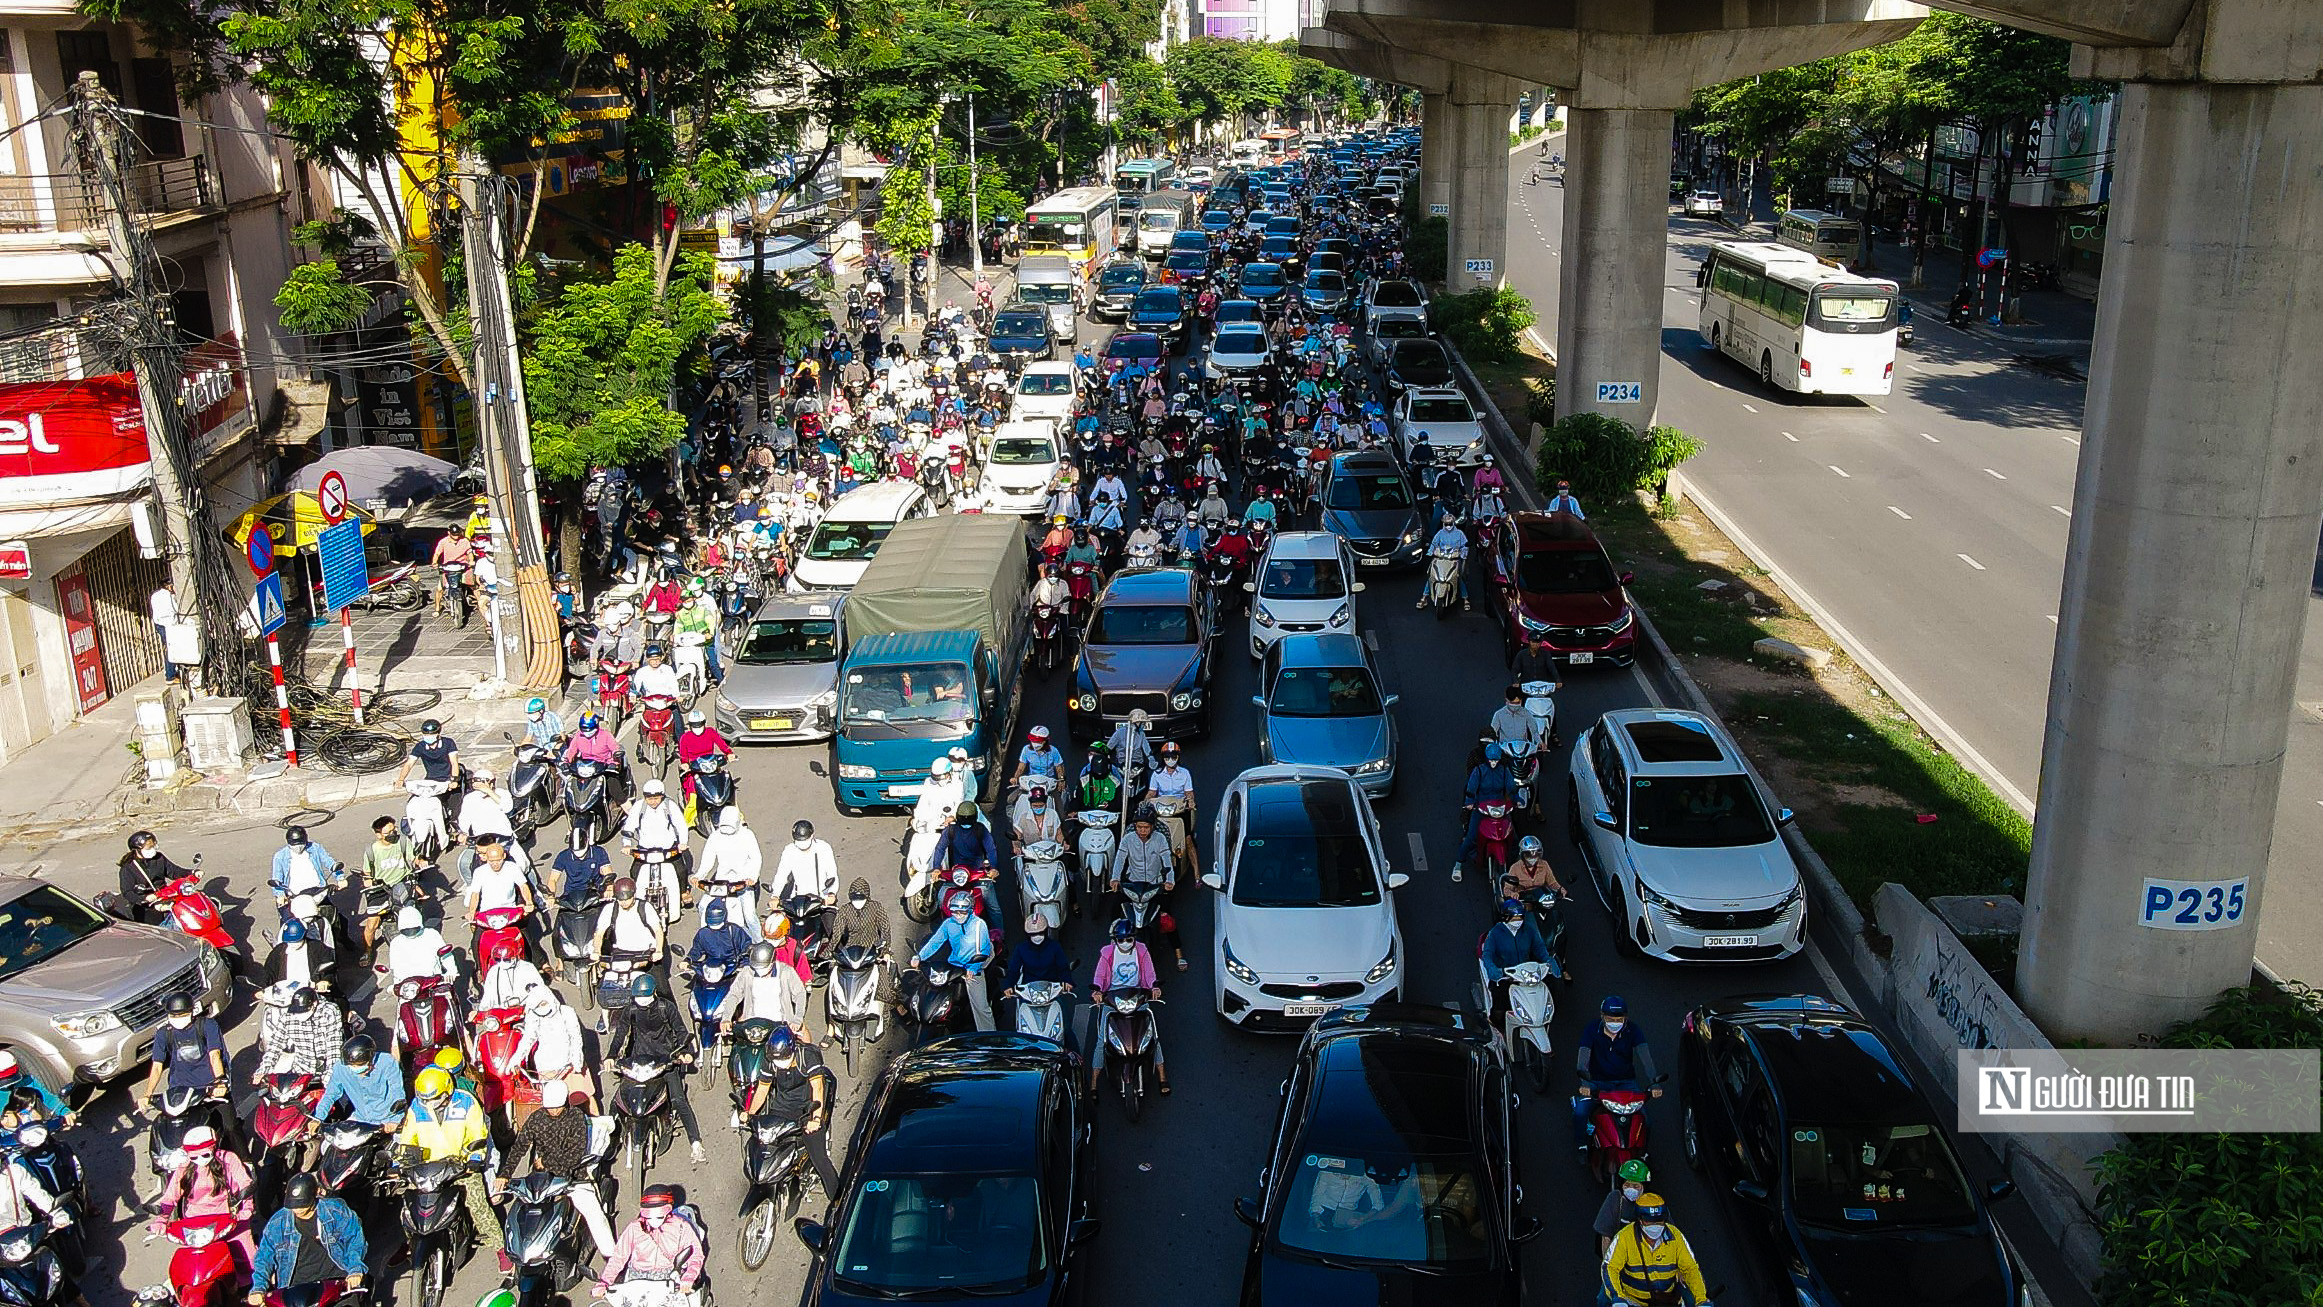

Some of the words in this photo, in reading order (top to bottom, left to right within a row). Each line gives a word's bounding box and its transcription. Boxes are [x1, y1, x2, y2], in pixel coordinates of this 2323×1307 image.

[1430, 205, 1449, 213] P232
[1466, 261, 1493, 272] P233
[363, 366, 412, 383] Made
[380, 387, 401, 404] in
[1599, 385, 1640, 400] P234
[372, 430, 415, 446] Nam
[2145, 883, 2245, 923] P235
